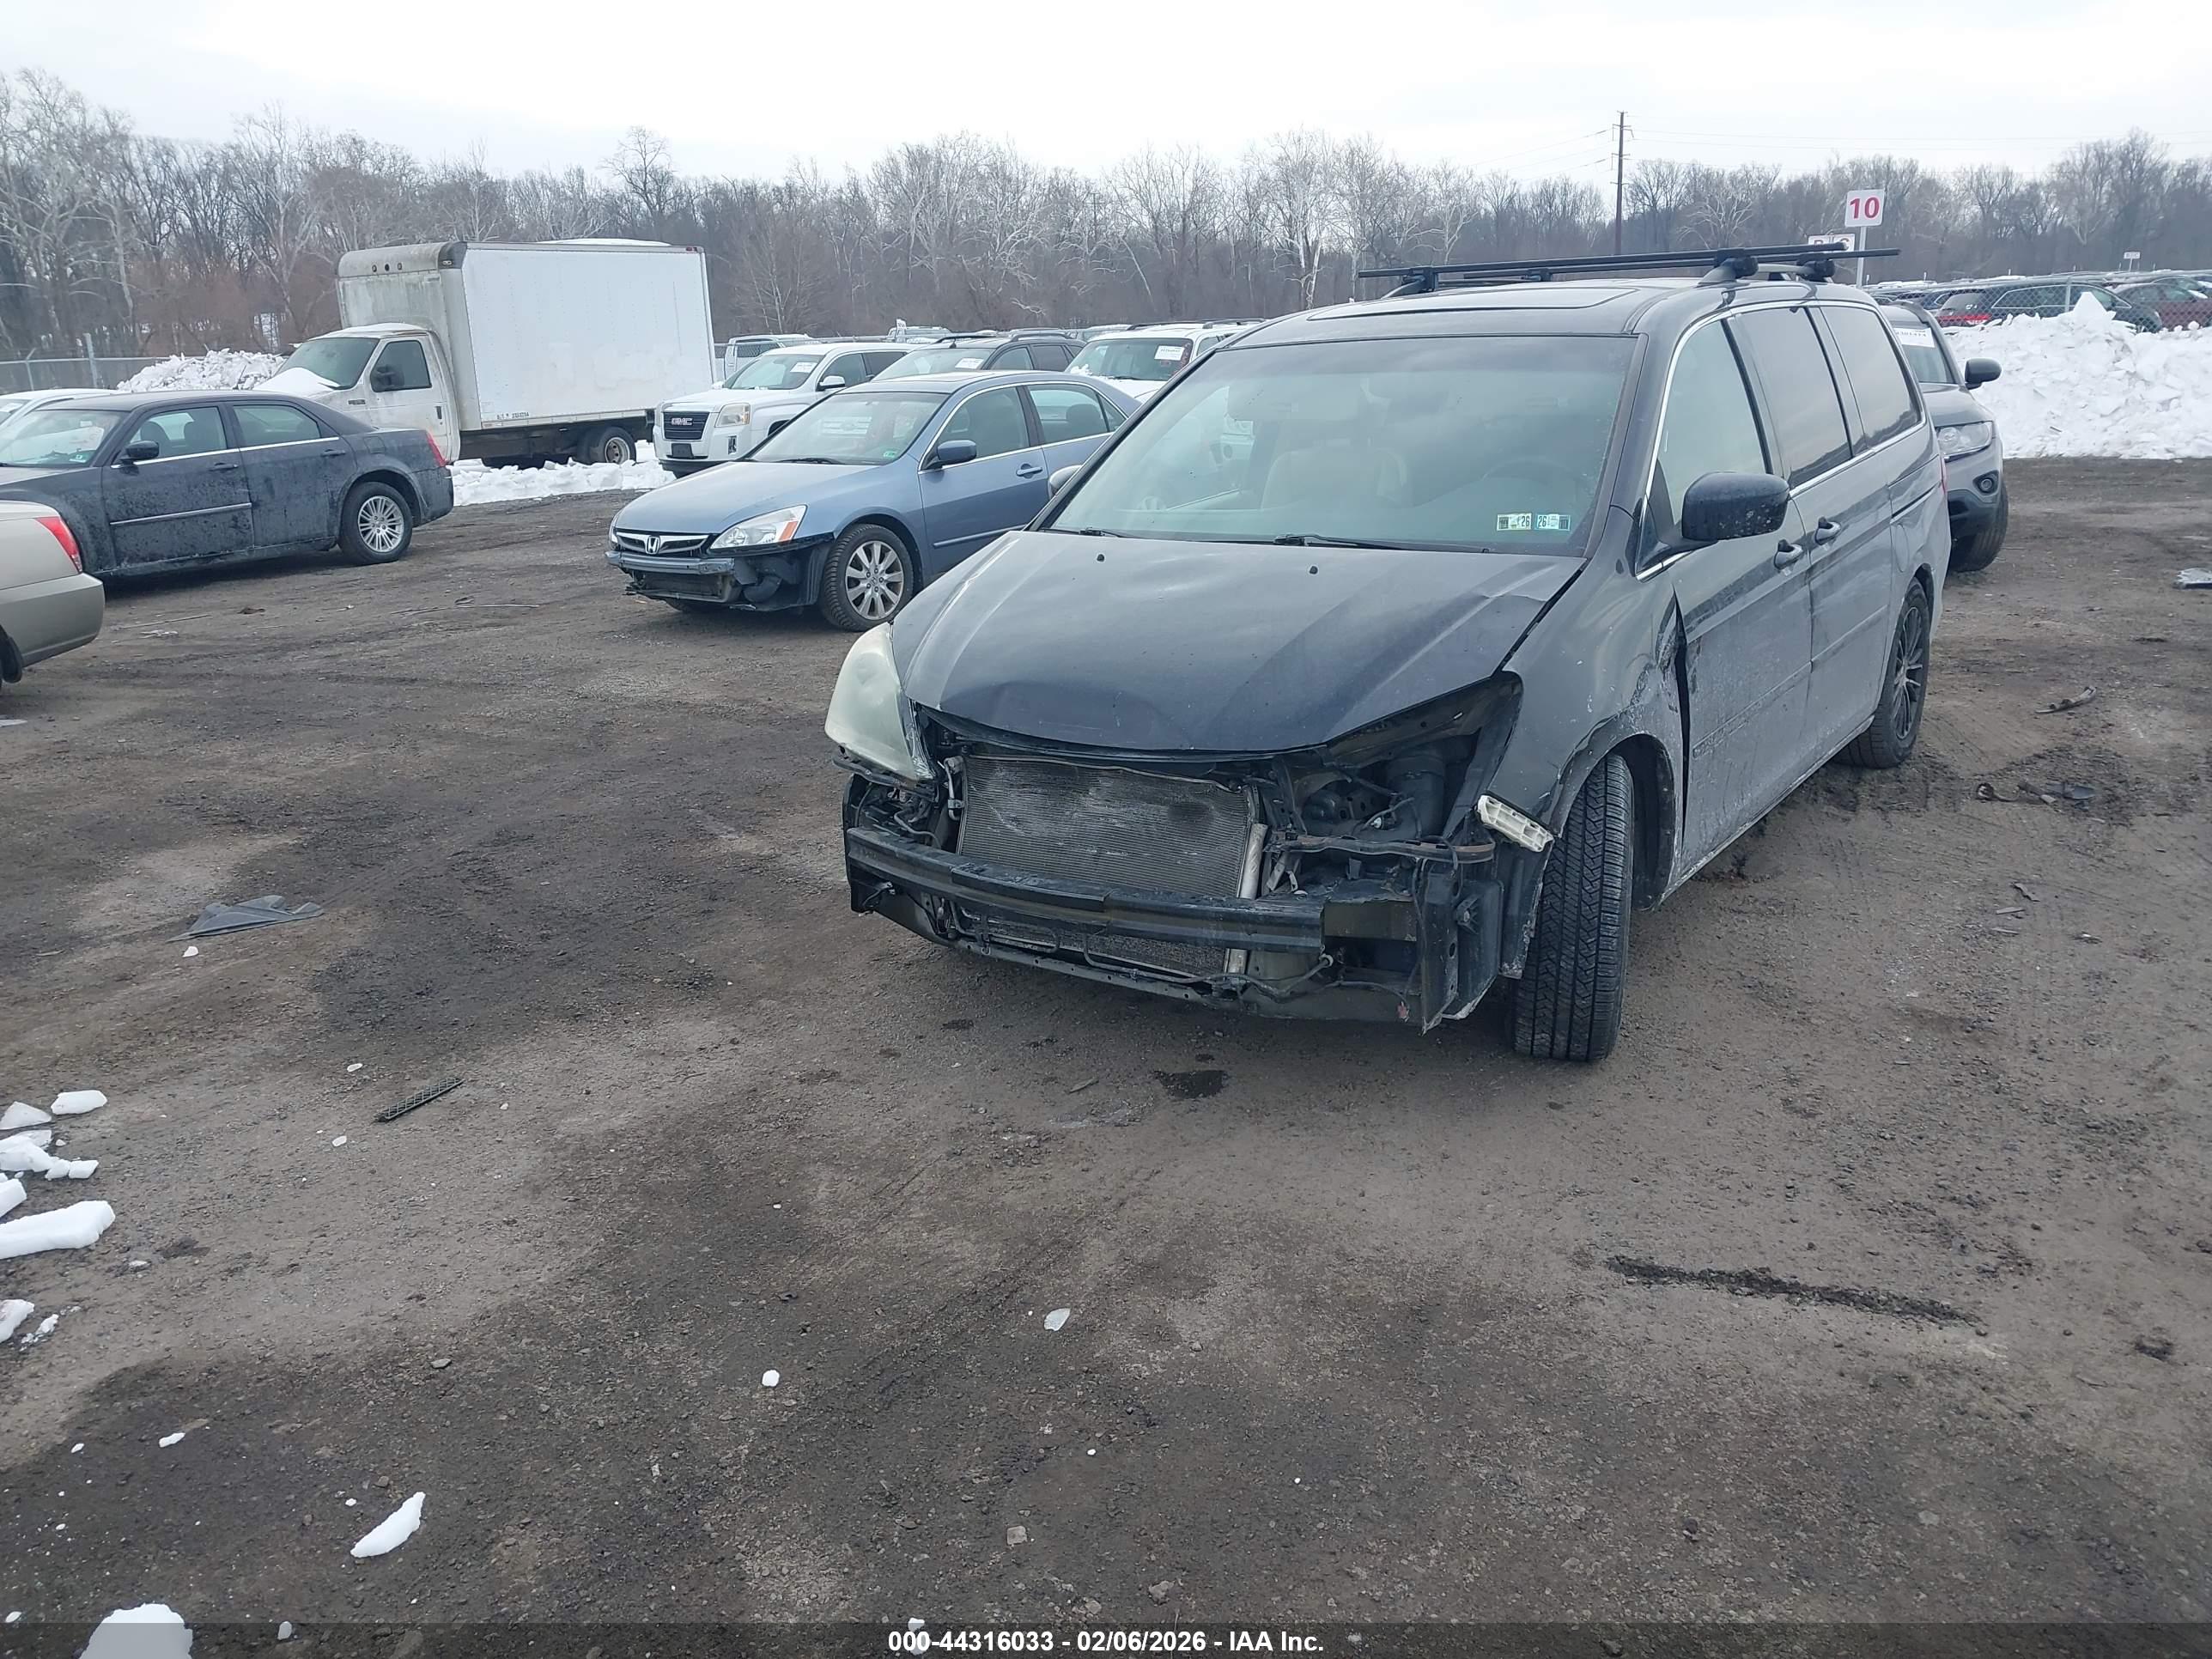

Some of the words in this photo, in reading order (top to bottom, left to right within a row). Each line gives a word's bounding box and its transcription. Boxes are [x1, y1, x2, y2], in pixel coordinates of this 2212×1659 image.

[1850, 197, 1880, 219] 10
[671, 417, 693, 426] GMC
[1521, 515, 1530, 527] 26
[1538, 515, 1547, 527] 26
